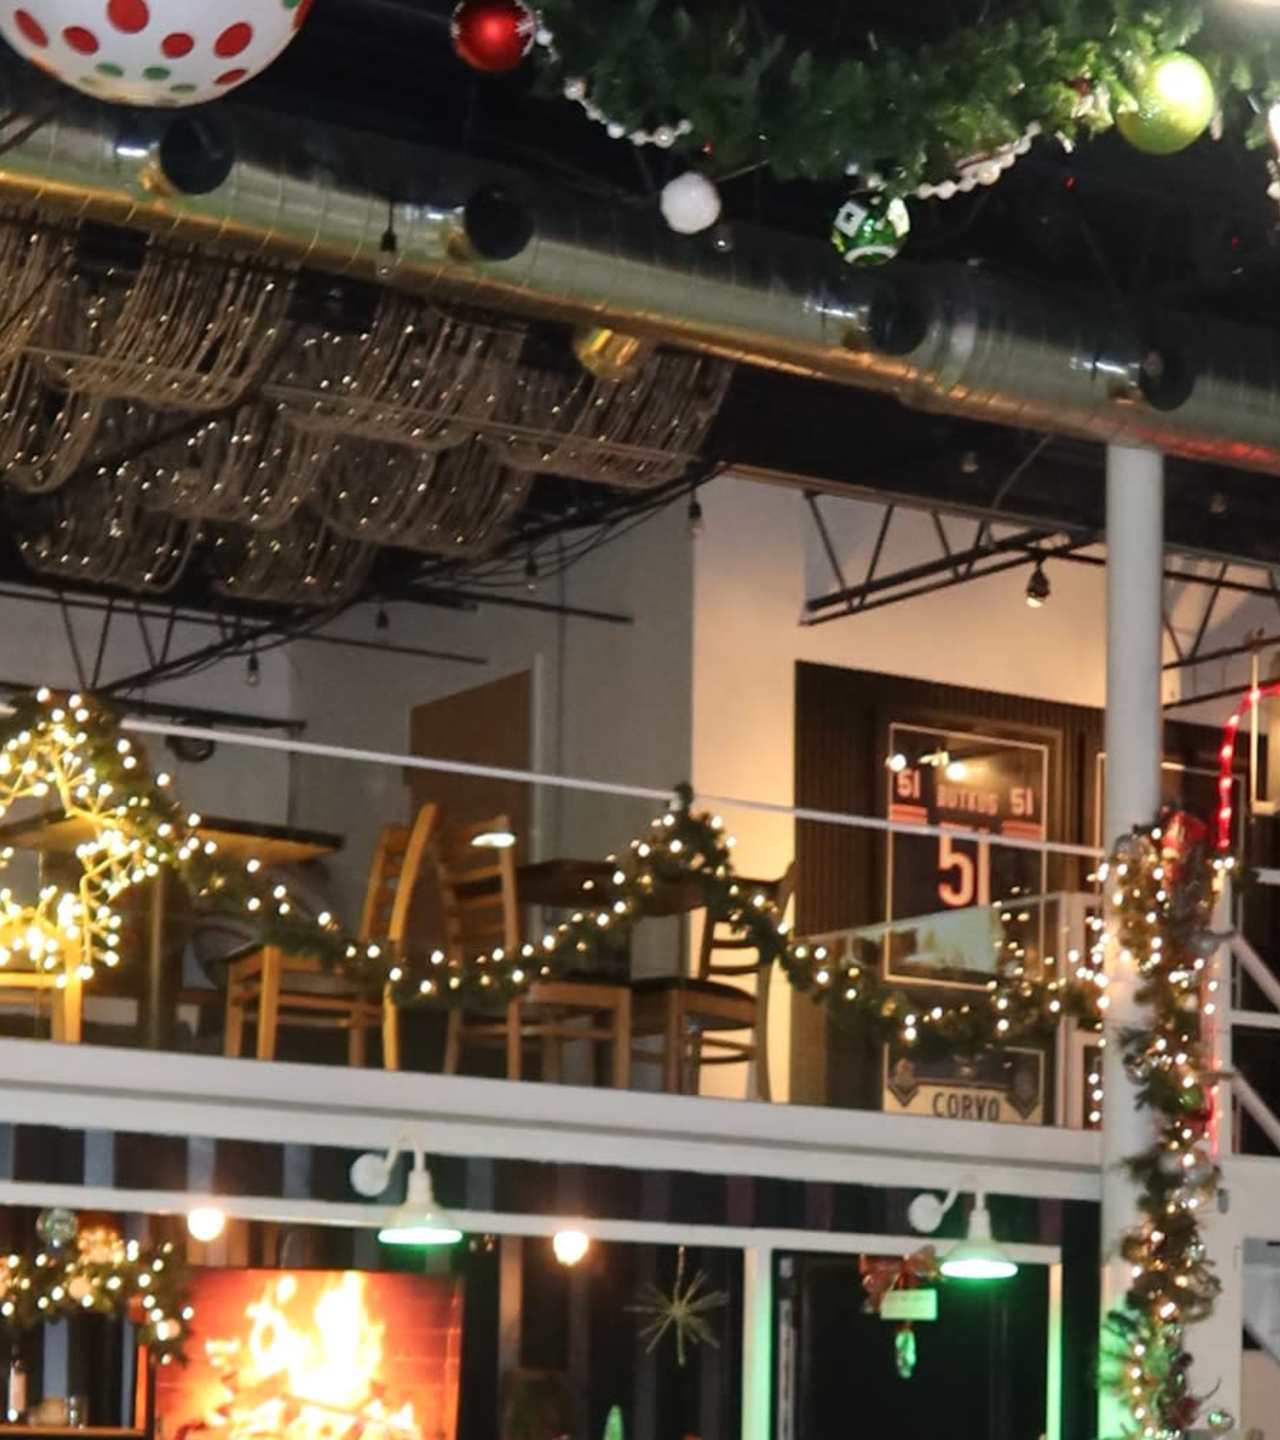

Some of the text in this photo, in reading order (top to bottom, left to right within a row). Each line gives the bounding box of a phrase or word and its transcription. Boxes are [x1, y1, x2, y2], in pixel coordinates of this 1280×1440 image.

[896, 768, 921, 799] 51
[1009, 786, 1034, 816] 51
[937, 821, 990, 907] 51
[931, 1091, 1001, 1121] CORVO
